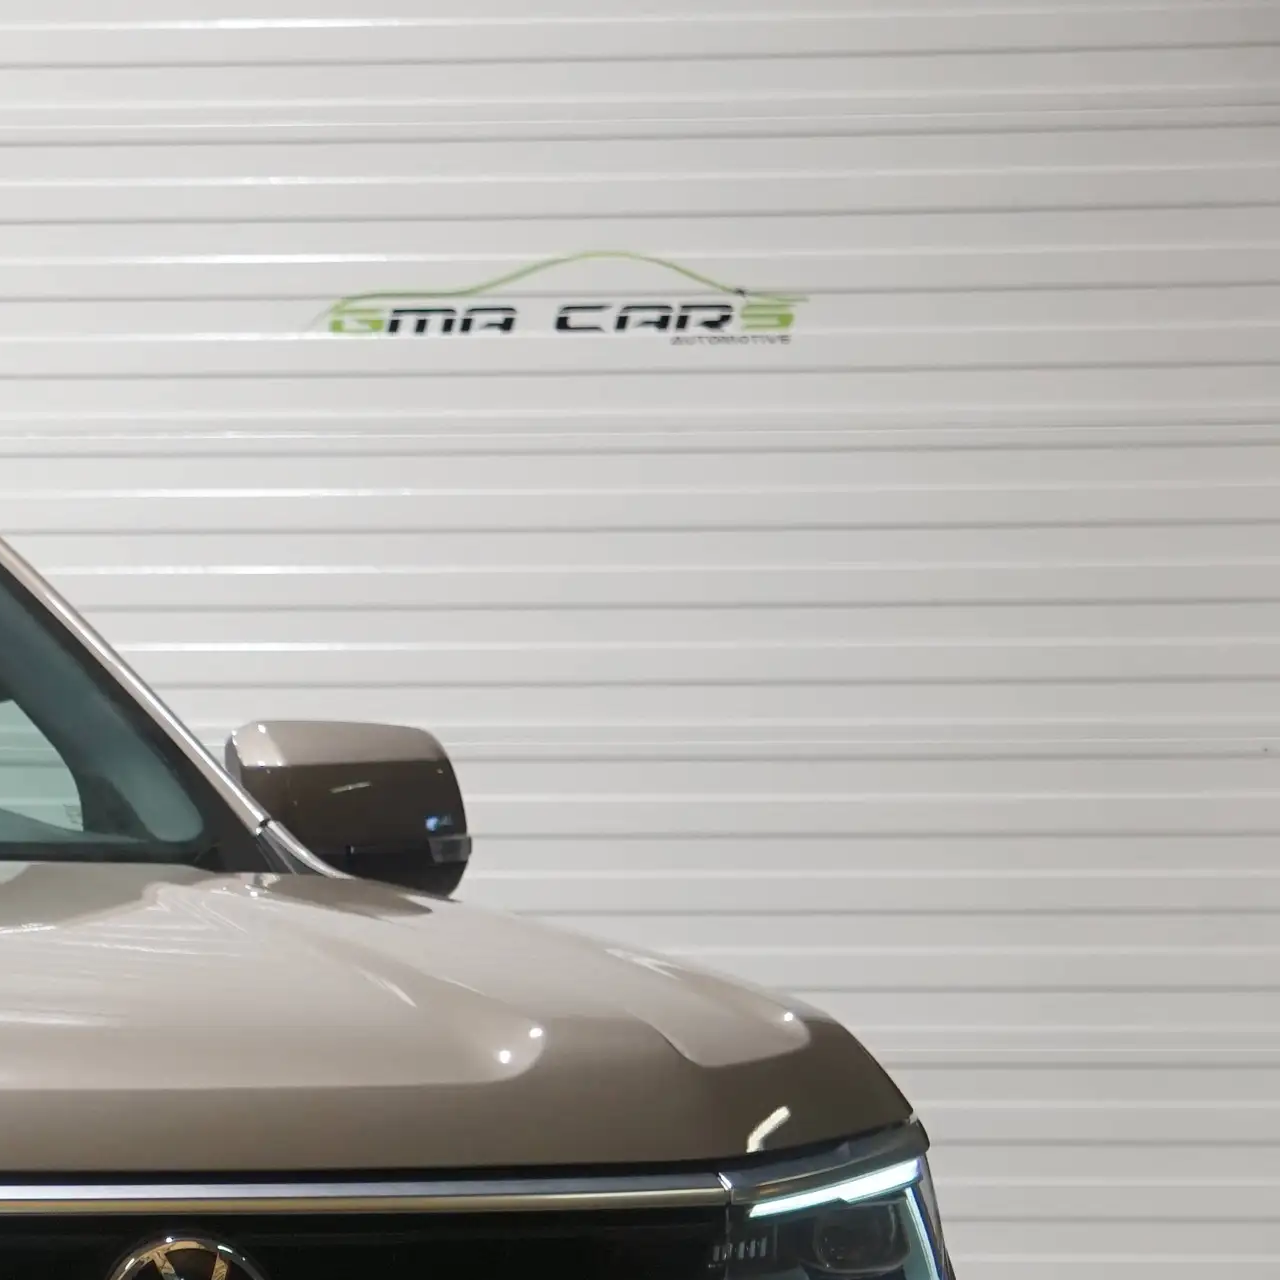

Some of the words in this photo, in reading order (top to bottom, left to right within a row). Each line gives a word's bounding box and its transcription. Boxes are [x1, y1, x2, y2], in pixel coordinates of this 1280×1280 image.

[330, 306, 517, 333] GMA
[555, 303, 796, 332] CARS
[670, 335, 791, 346] AUTOMOTIVE
